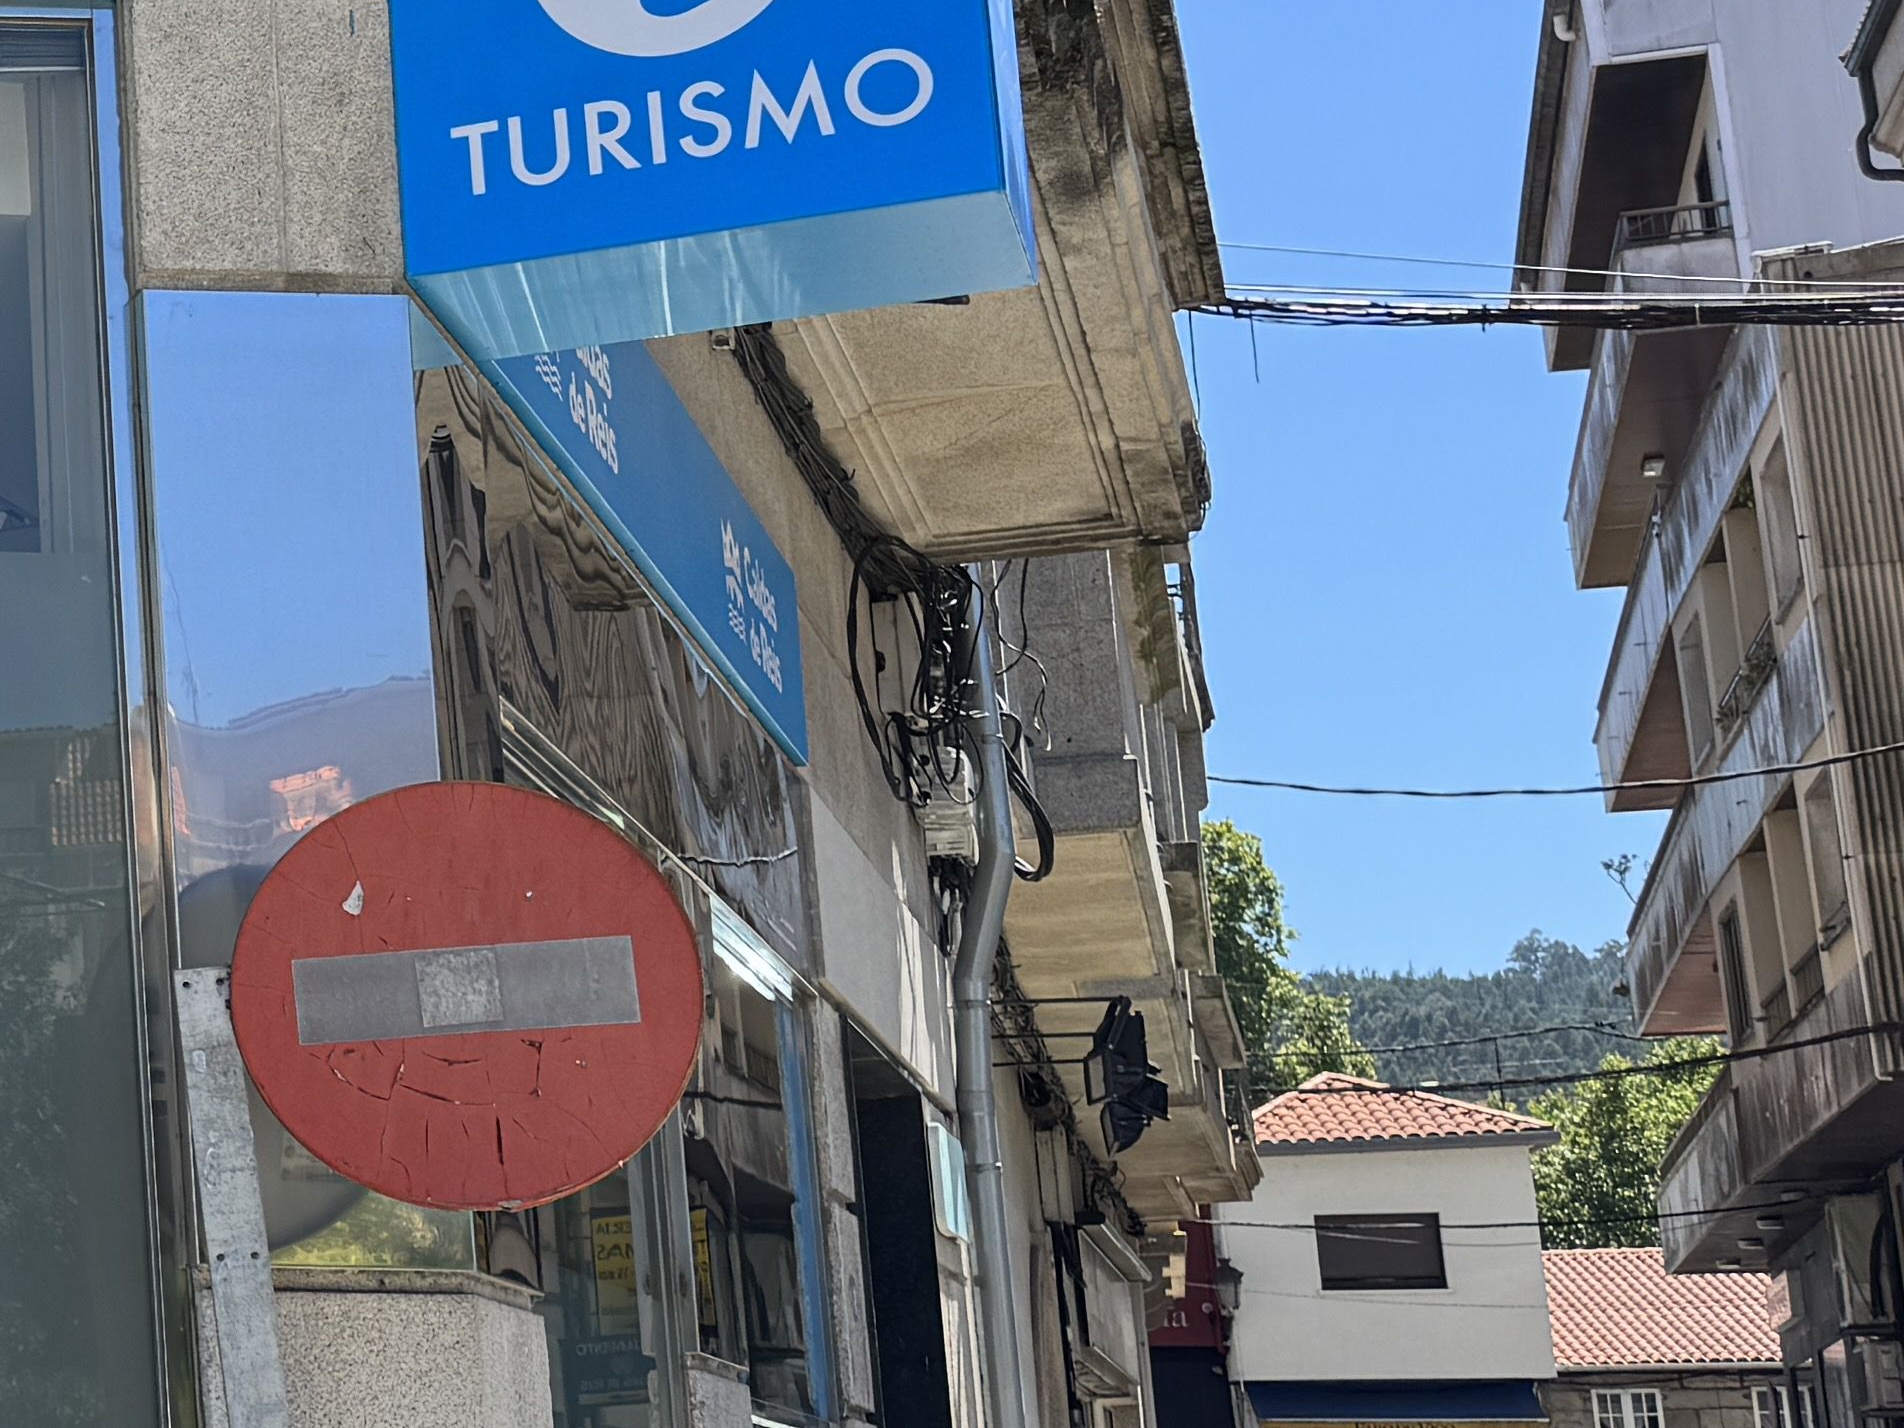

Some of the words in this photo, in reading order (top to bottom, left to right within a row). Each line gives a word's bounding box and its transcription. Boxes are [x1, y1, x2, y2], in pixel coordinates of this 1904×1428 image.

[450, 48, 934, 196] TURISMO
[569, 371, 586, 433] de
[584, 380, 619, 474] Reis
[744, 546, 777, 632] Caldas
[759, 622, 783, 694] Reis
